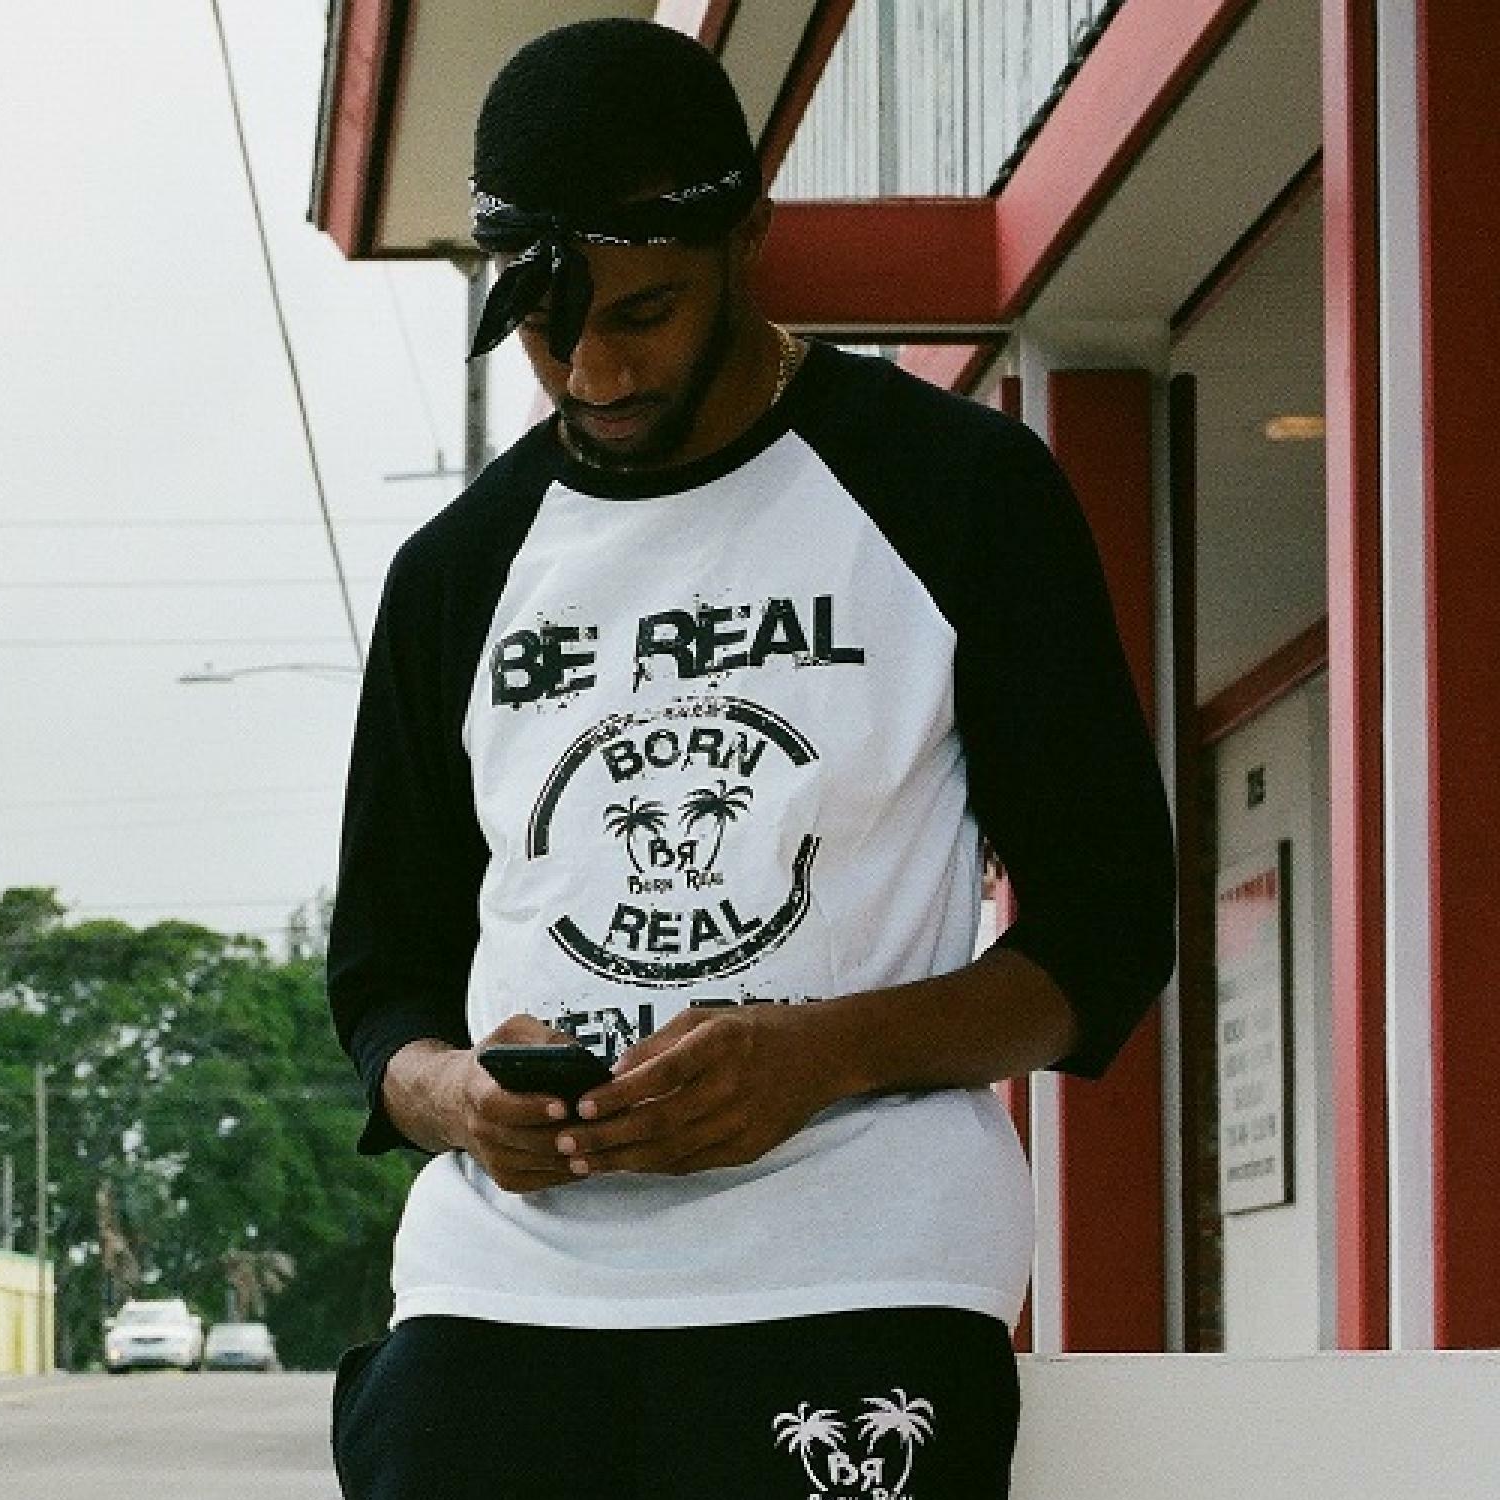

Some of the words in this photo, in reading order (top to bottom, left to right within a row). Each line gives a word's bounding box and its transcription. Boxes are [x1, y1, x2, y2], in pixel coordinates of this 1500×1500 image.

[491, 620, 597, 706] BE
[632, 594, 866, 692] REAL
[601, 727, 767, 783] BORN
[604, 898, 763, 953] REAL
